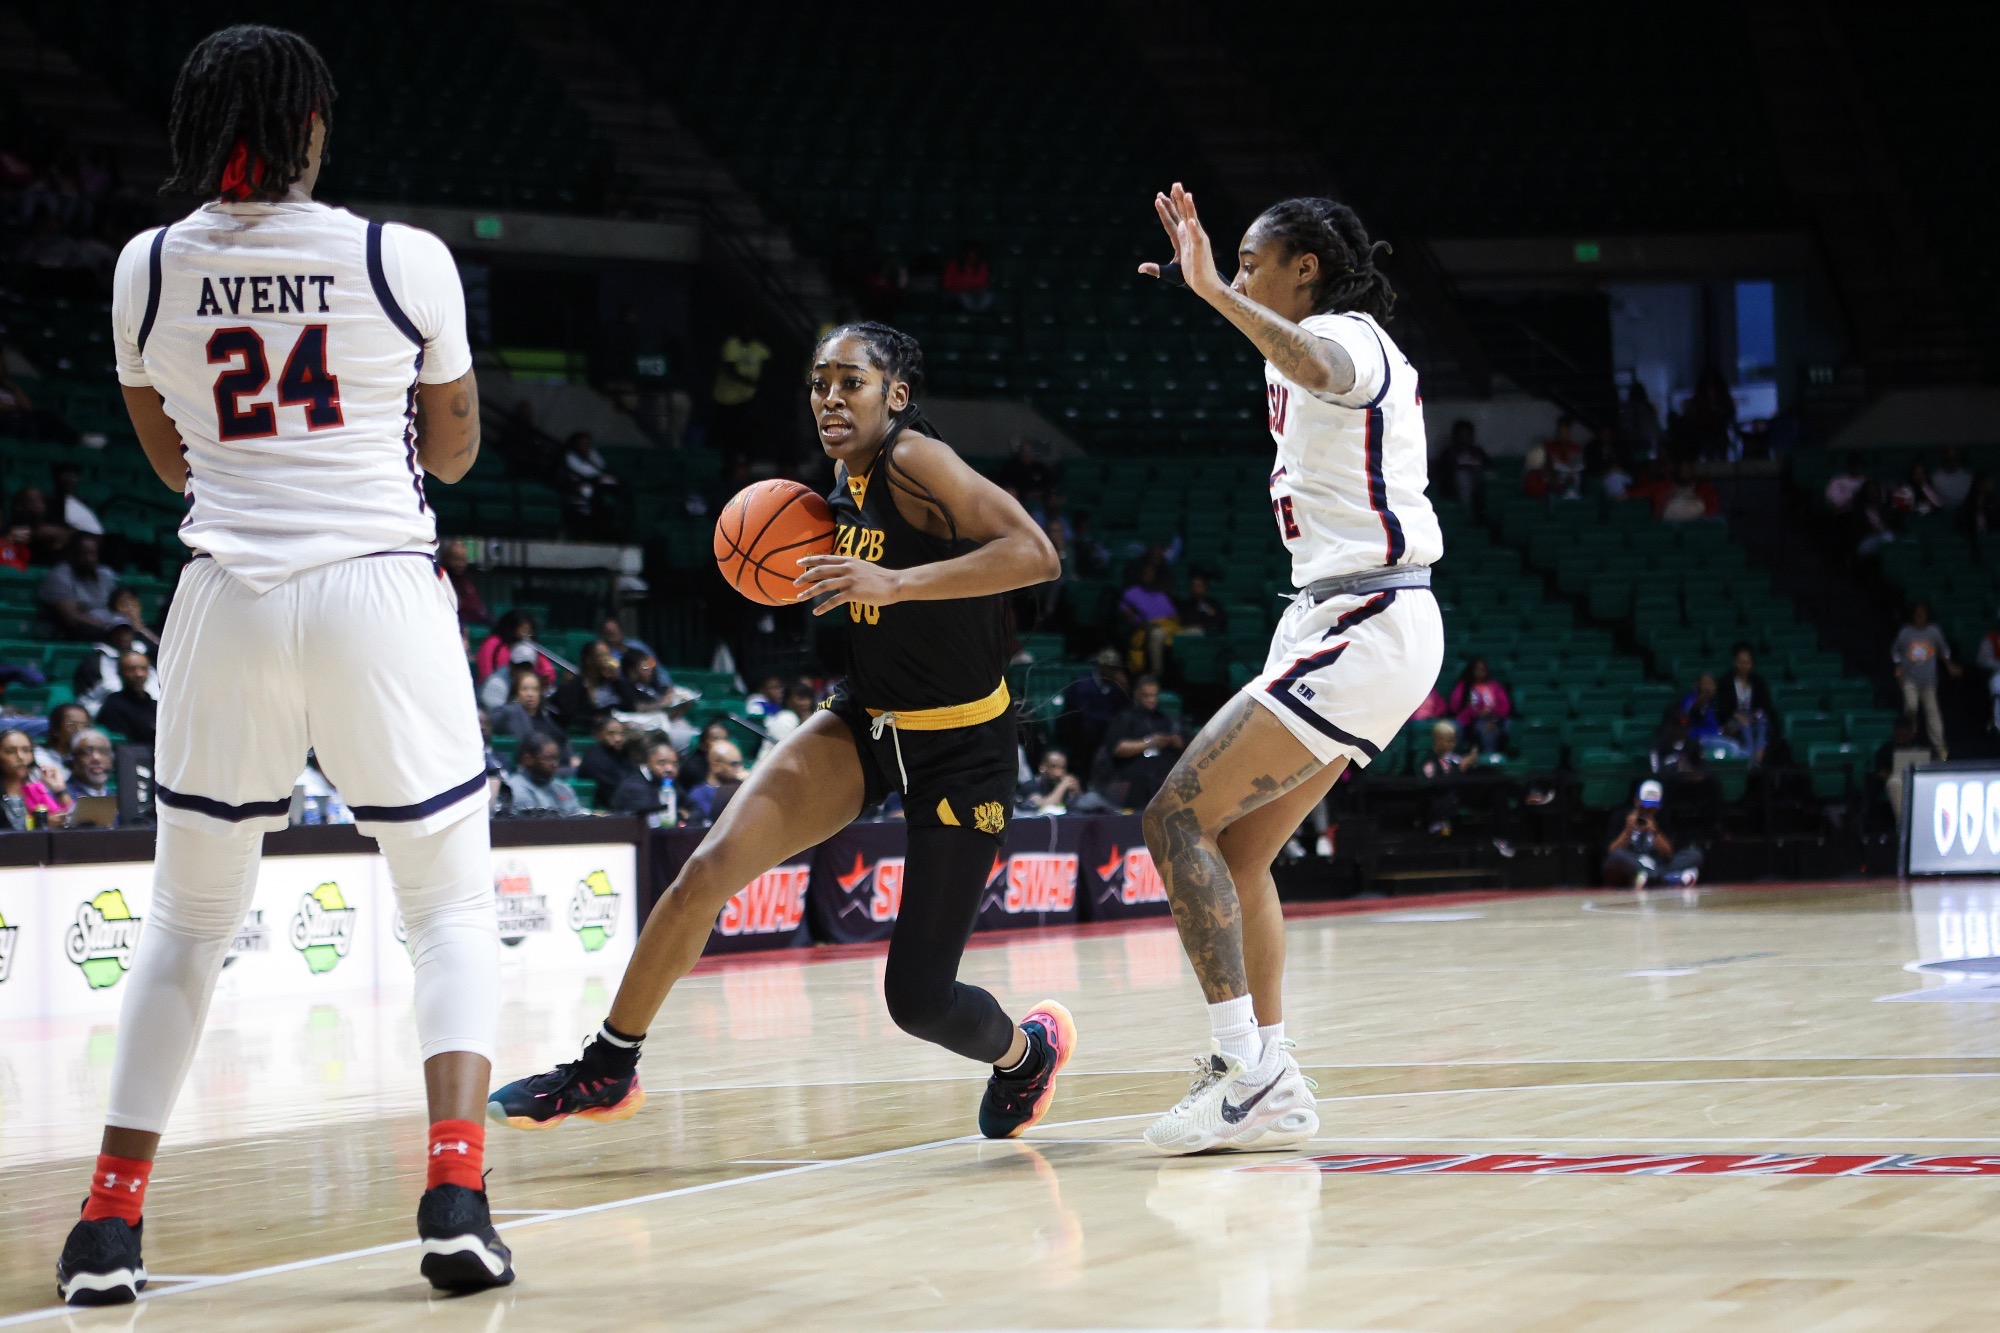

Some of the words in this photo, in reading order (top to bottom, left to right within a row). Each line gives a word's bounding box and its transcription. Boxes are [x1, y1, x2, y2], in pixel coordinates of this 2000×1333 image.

[196, 275, 335, 316] AVENT
[205, 324, 345, 442] 24
[1004, 853, 1079, 914] SWAC
[65, 901, 142, 971] Starry
[289, 892, 358, 957] Starry
